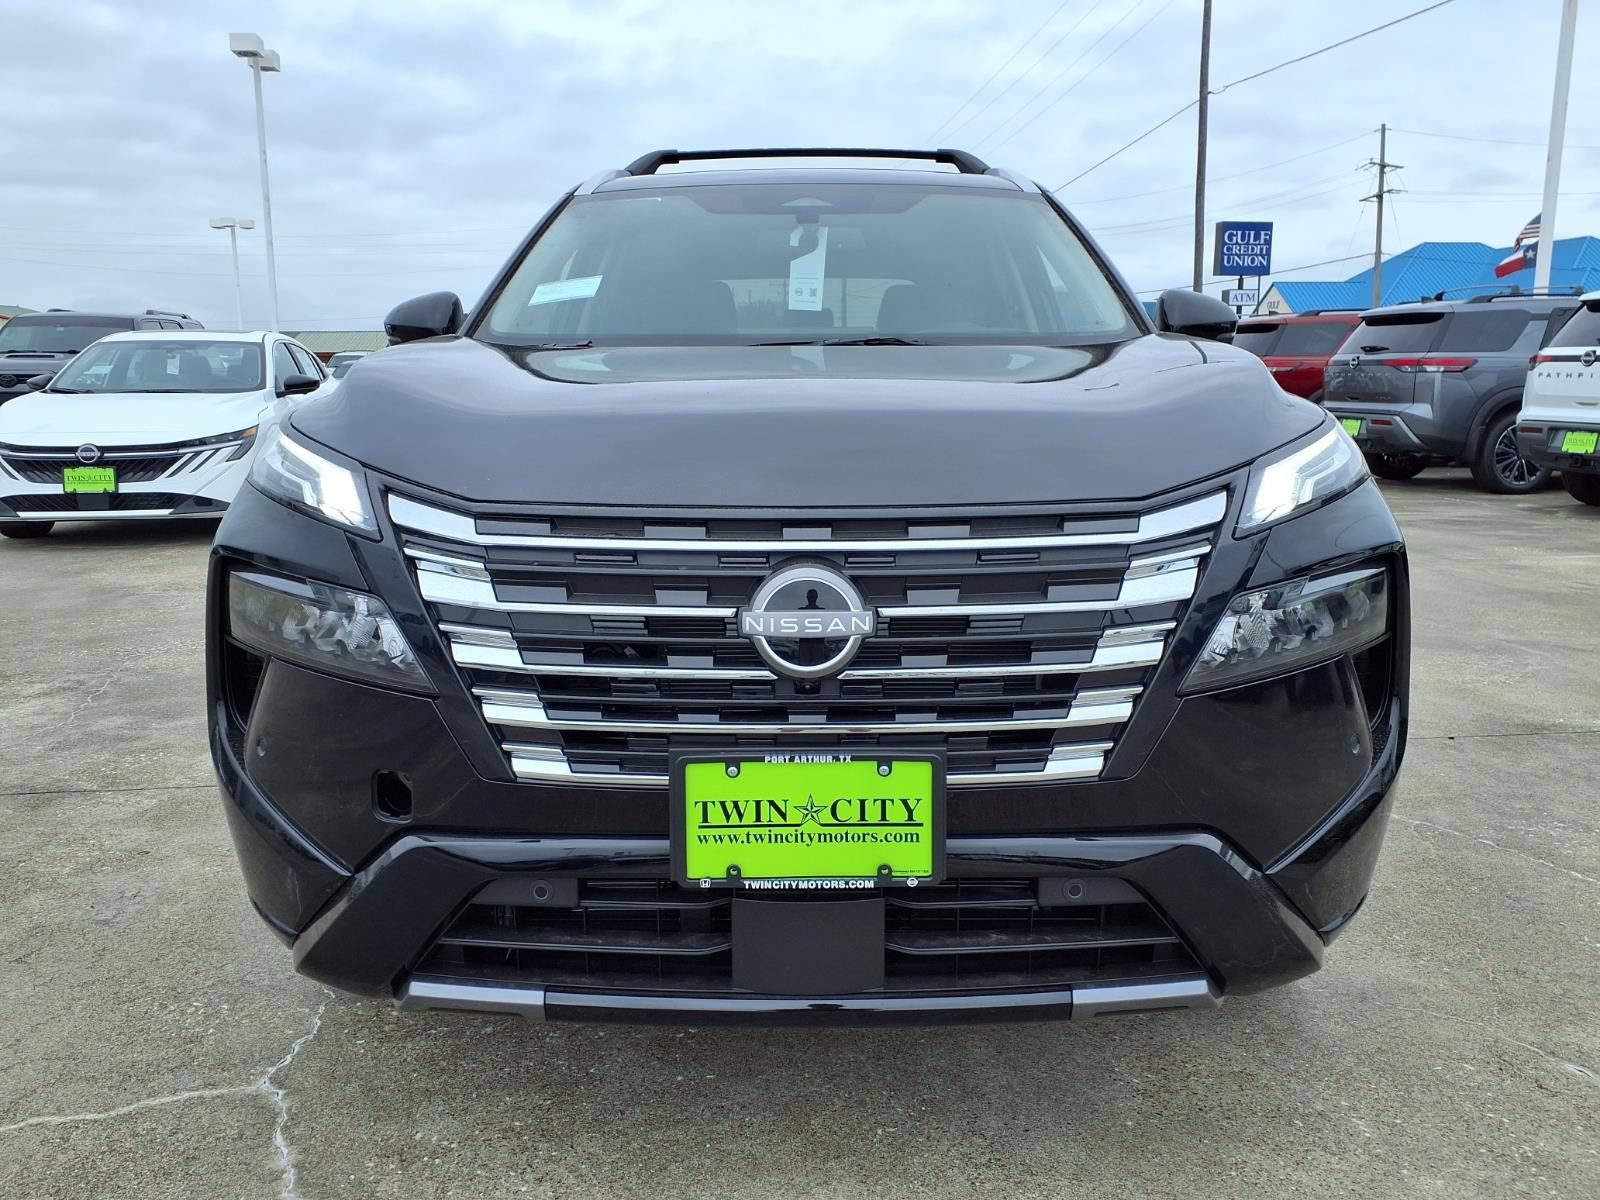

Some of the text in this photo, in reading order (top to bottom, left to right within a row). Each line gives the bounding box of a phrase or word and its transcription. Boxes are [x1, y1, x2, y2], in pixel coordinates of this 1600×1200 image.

[1224, 230, 1271, 244] GULF
[1223, 244, 1269, 255] CREDIT
[1223, 255, 1268, 267] UNION
[1231, 293, 1256, 303] ATM
[745, 616, 870, 633] NISSAN
[764, 755, 791, 764] PORT
[838, 755, 852, 763] TX
[695, 798, 922, 824] TWIN CITY
[697, 829, 920, 848] www.twincitymotors.com
[743, 879, 875, 890] TWINCITYMOTORS.COM
